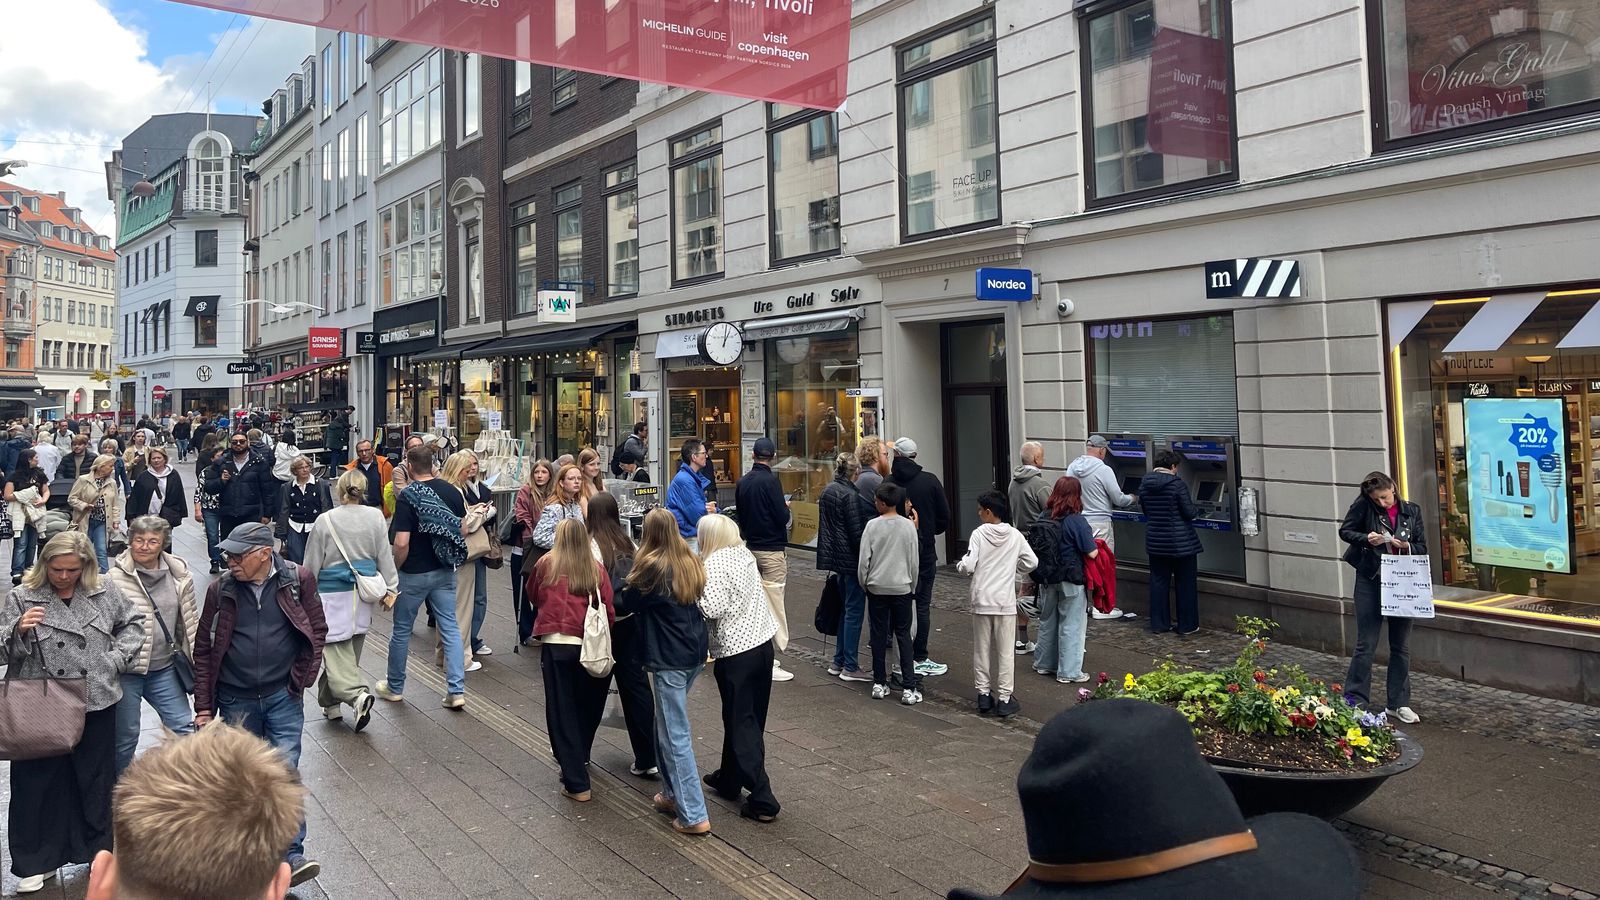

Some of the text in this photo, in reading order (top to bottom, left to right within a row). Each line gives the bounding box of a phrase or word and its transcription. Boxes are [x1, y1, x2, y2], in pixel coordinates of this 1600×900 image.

[642, 18, 727, 42] MICHELIN GUIDE
[763, 31, 788, 45] visit
[661, 43, 694, 54] RESTAURANT
[737, 42, 810, 62] copenhagen
[1421, 40, 1569, 96] Vitus Guld
[1443, 87, 1550, 117] Danish Vintage
[952, 169, 992, 189] FACE UP
[953, 183, 992, 198] SKINCARE
[943, 278, 950, 291] 7
[987, 279, 1027, 290] Nordea
[1211, 270, 1232, 288] m
[664, 286, 860, 327] STRØGETS Ure Guld Sølv
[683, 334, 698, 343] SKA
[230, 364, 255, 372] Normal
[1538, 382, 1573, 393] CLARINS
[1518, 427, 1548, 444] 20%
[635, 487, 657, 495] UDSALG
